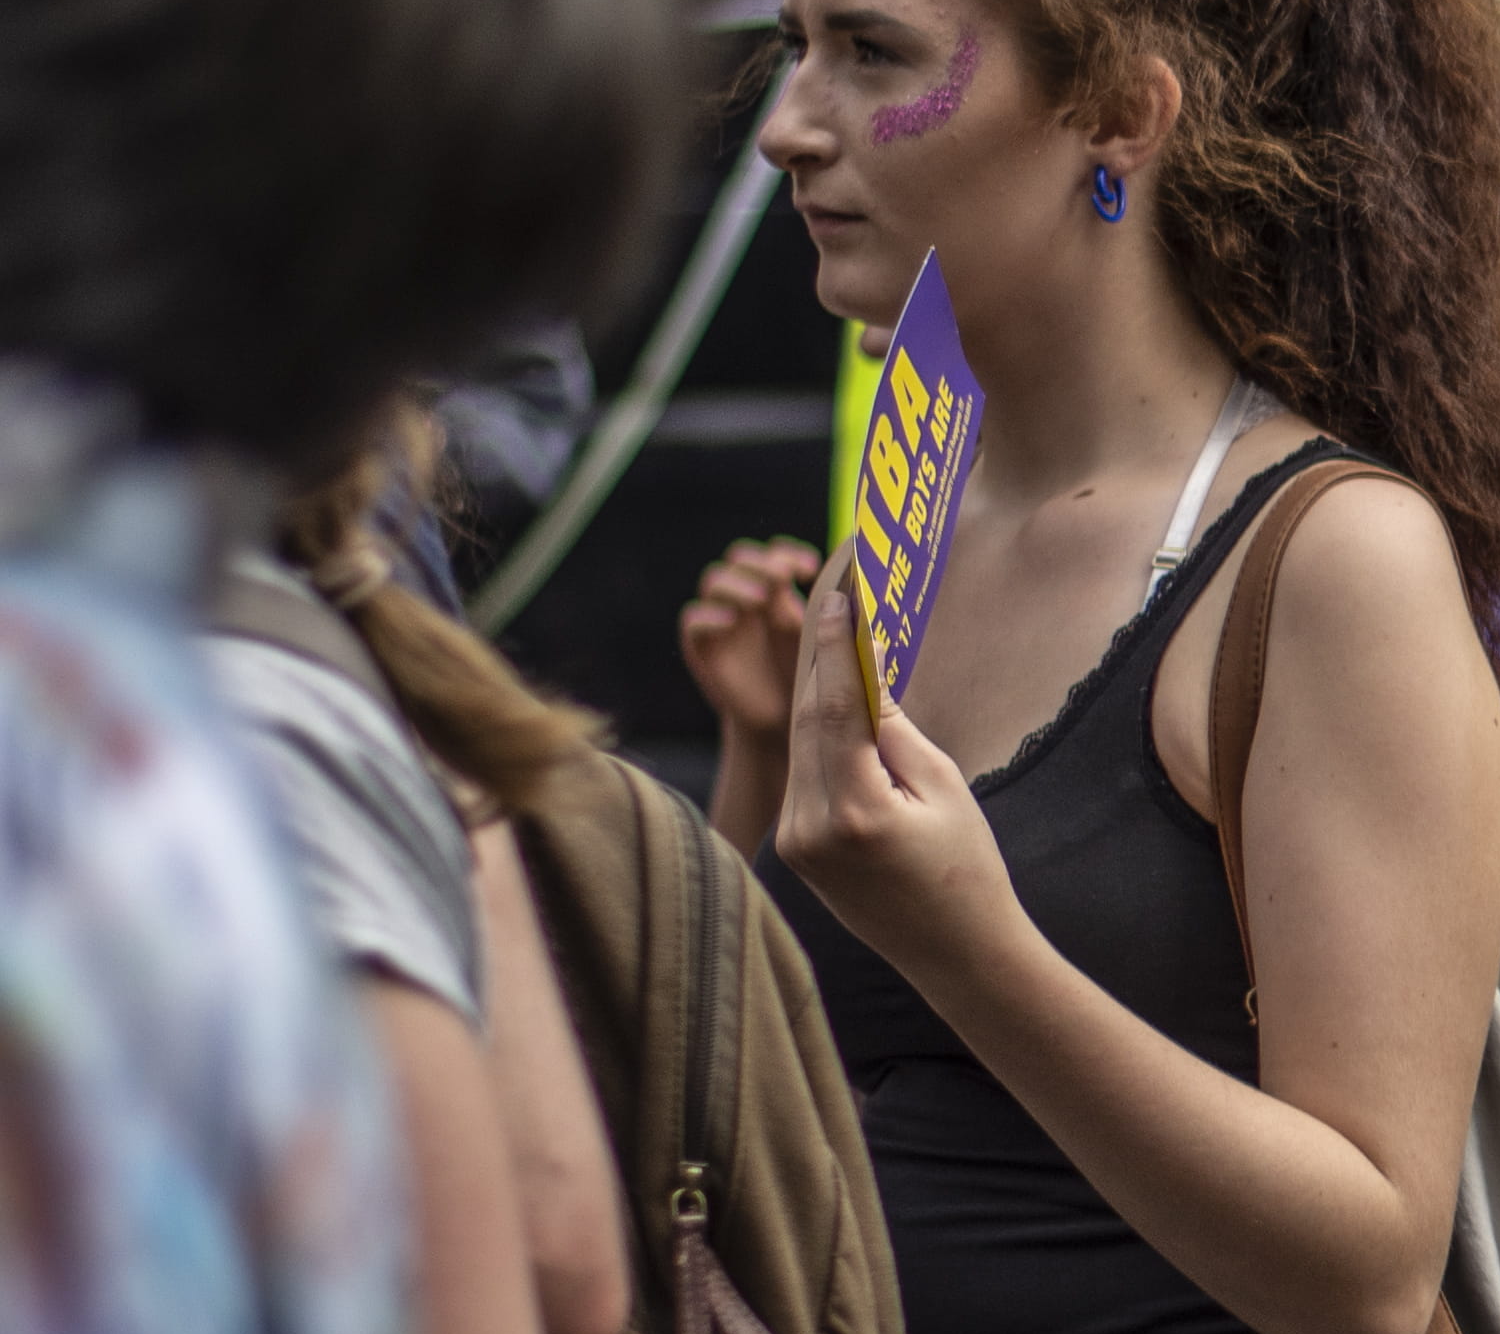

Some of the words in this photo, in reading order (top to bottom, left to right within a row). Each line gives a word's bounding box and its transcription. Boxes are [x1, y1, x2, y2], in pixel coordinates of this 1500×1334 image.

[855, 345, 931, 625] TBA
[884, 543, 912, 616] THE
[905, 451, 935, 548] BOYS
[930, 374, 954, 455] ARE
[894, 612, 912, 649] '17
